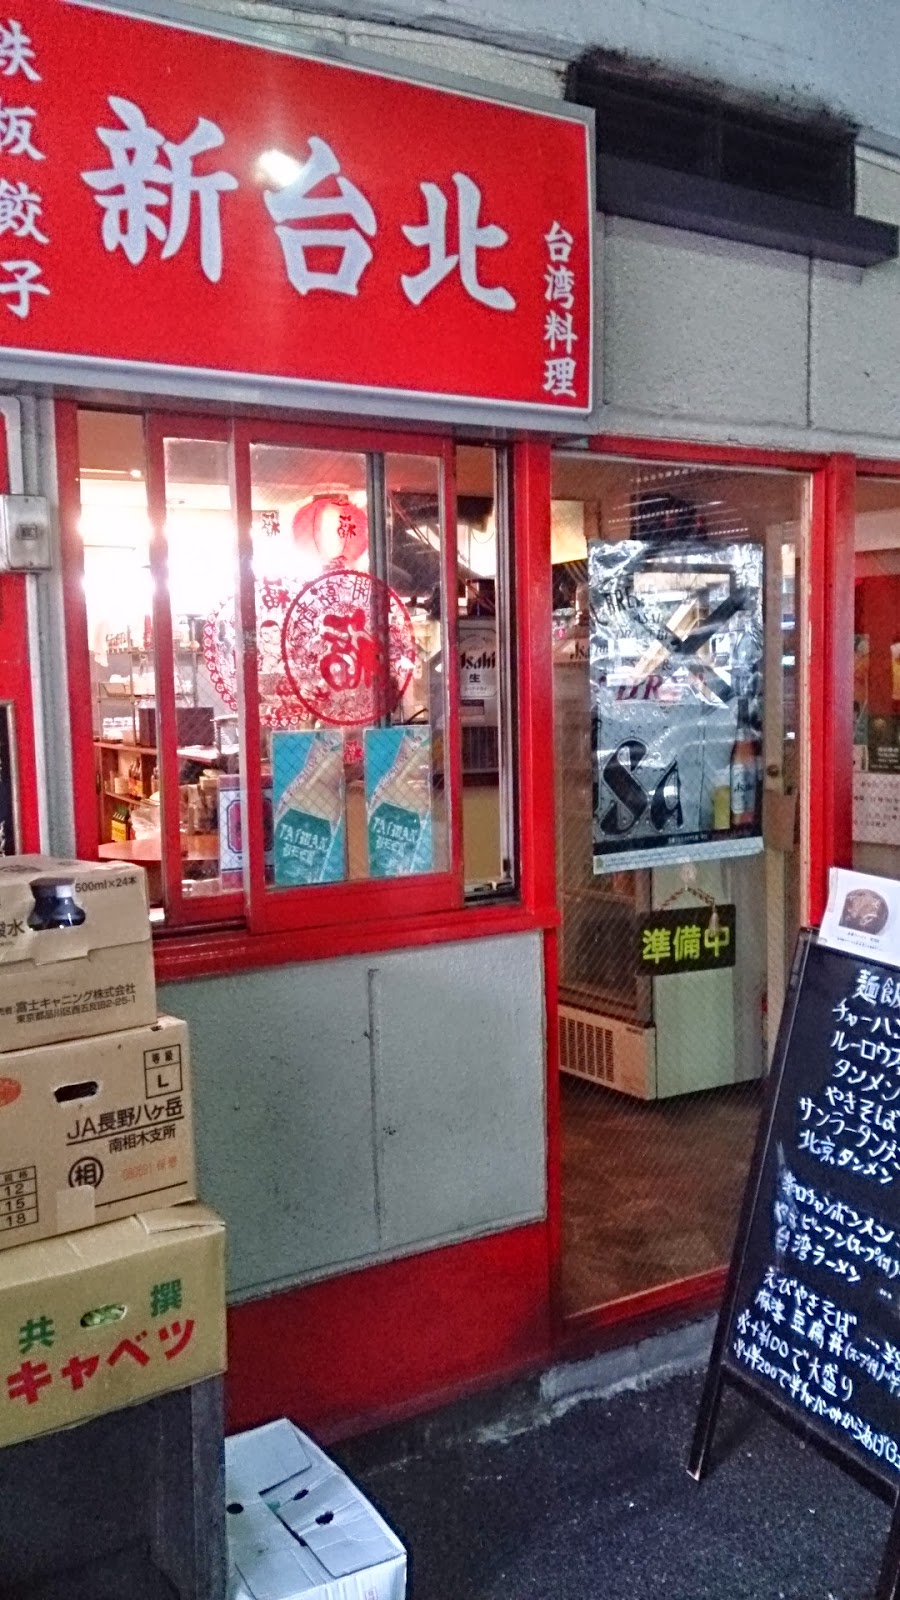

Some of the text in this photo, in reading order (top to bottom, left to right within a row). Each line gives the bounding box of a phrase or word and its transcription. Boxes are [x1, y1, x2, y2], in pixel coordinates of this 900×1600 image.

[80, 95, 517, 311] 新台北
[543, 221, 578, 397] 台湾料理
[469, 673, 481, 684] 生
[642, 925, 730, 964] 準備中
[16, 983, 136, 1014] 富士キャニング株式会社
[158, 1075, 169, 1088] L
[832, 1059, 900, 1101] タンメン
[825, 1086, 900, 1133] やきそば
[108, 1124, 176, 1153] 南相木支所
[798, 1130, 893, 1184] 北京タンメン
[4, 1183, 24, 1197] 12
[5, 1197, 25, 1212] 15
[6, 1213, 26, 1227] 18
[776, 1225, 861, 1282] 台湾ラーメン
[18, 1315, 55, 1354] 共
[7, 1319, 195, 1405] キャベツ
